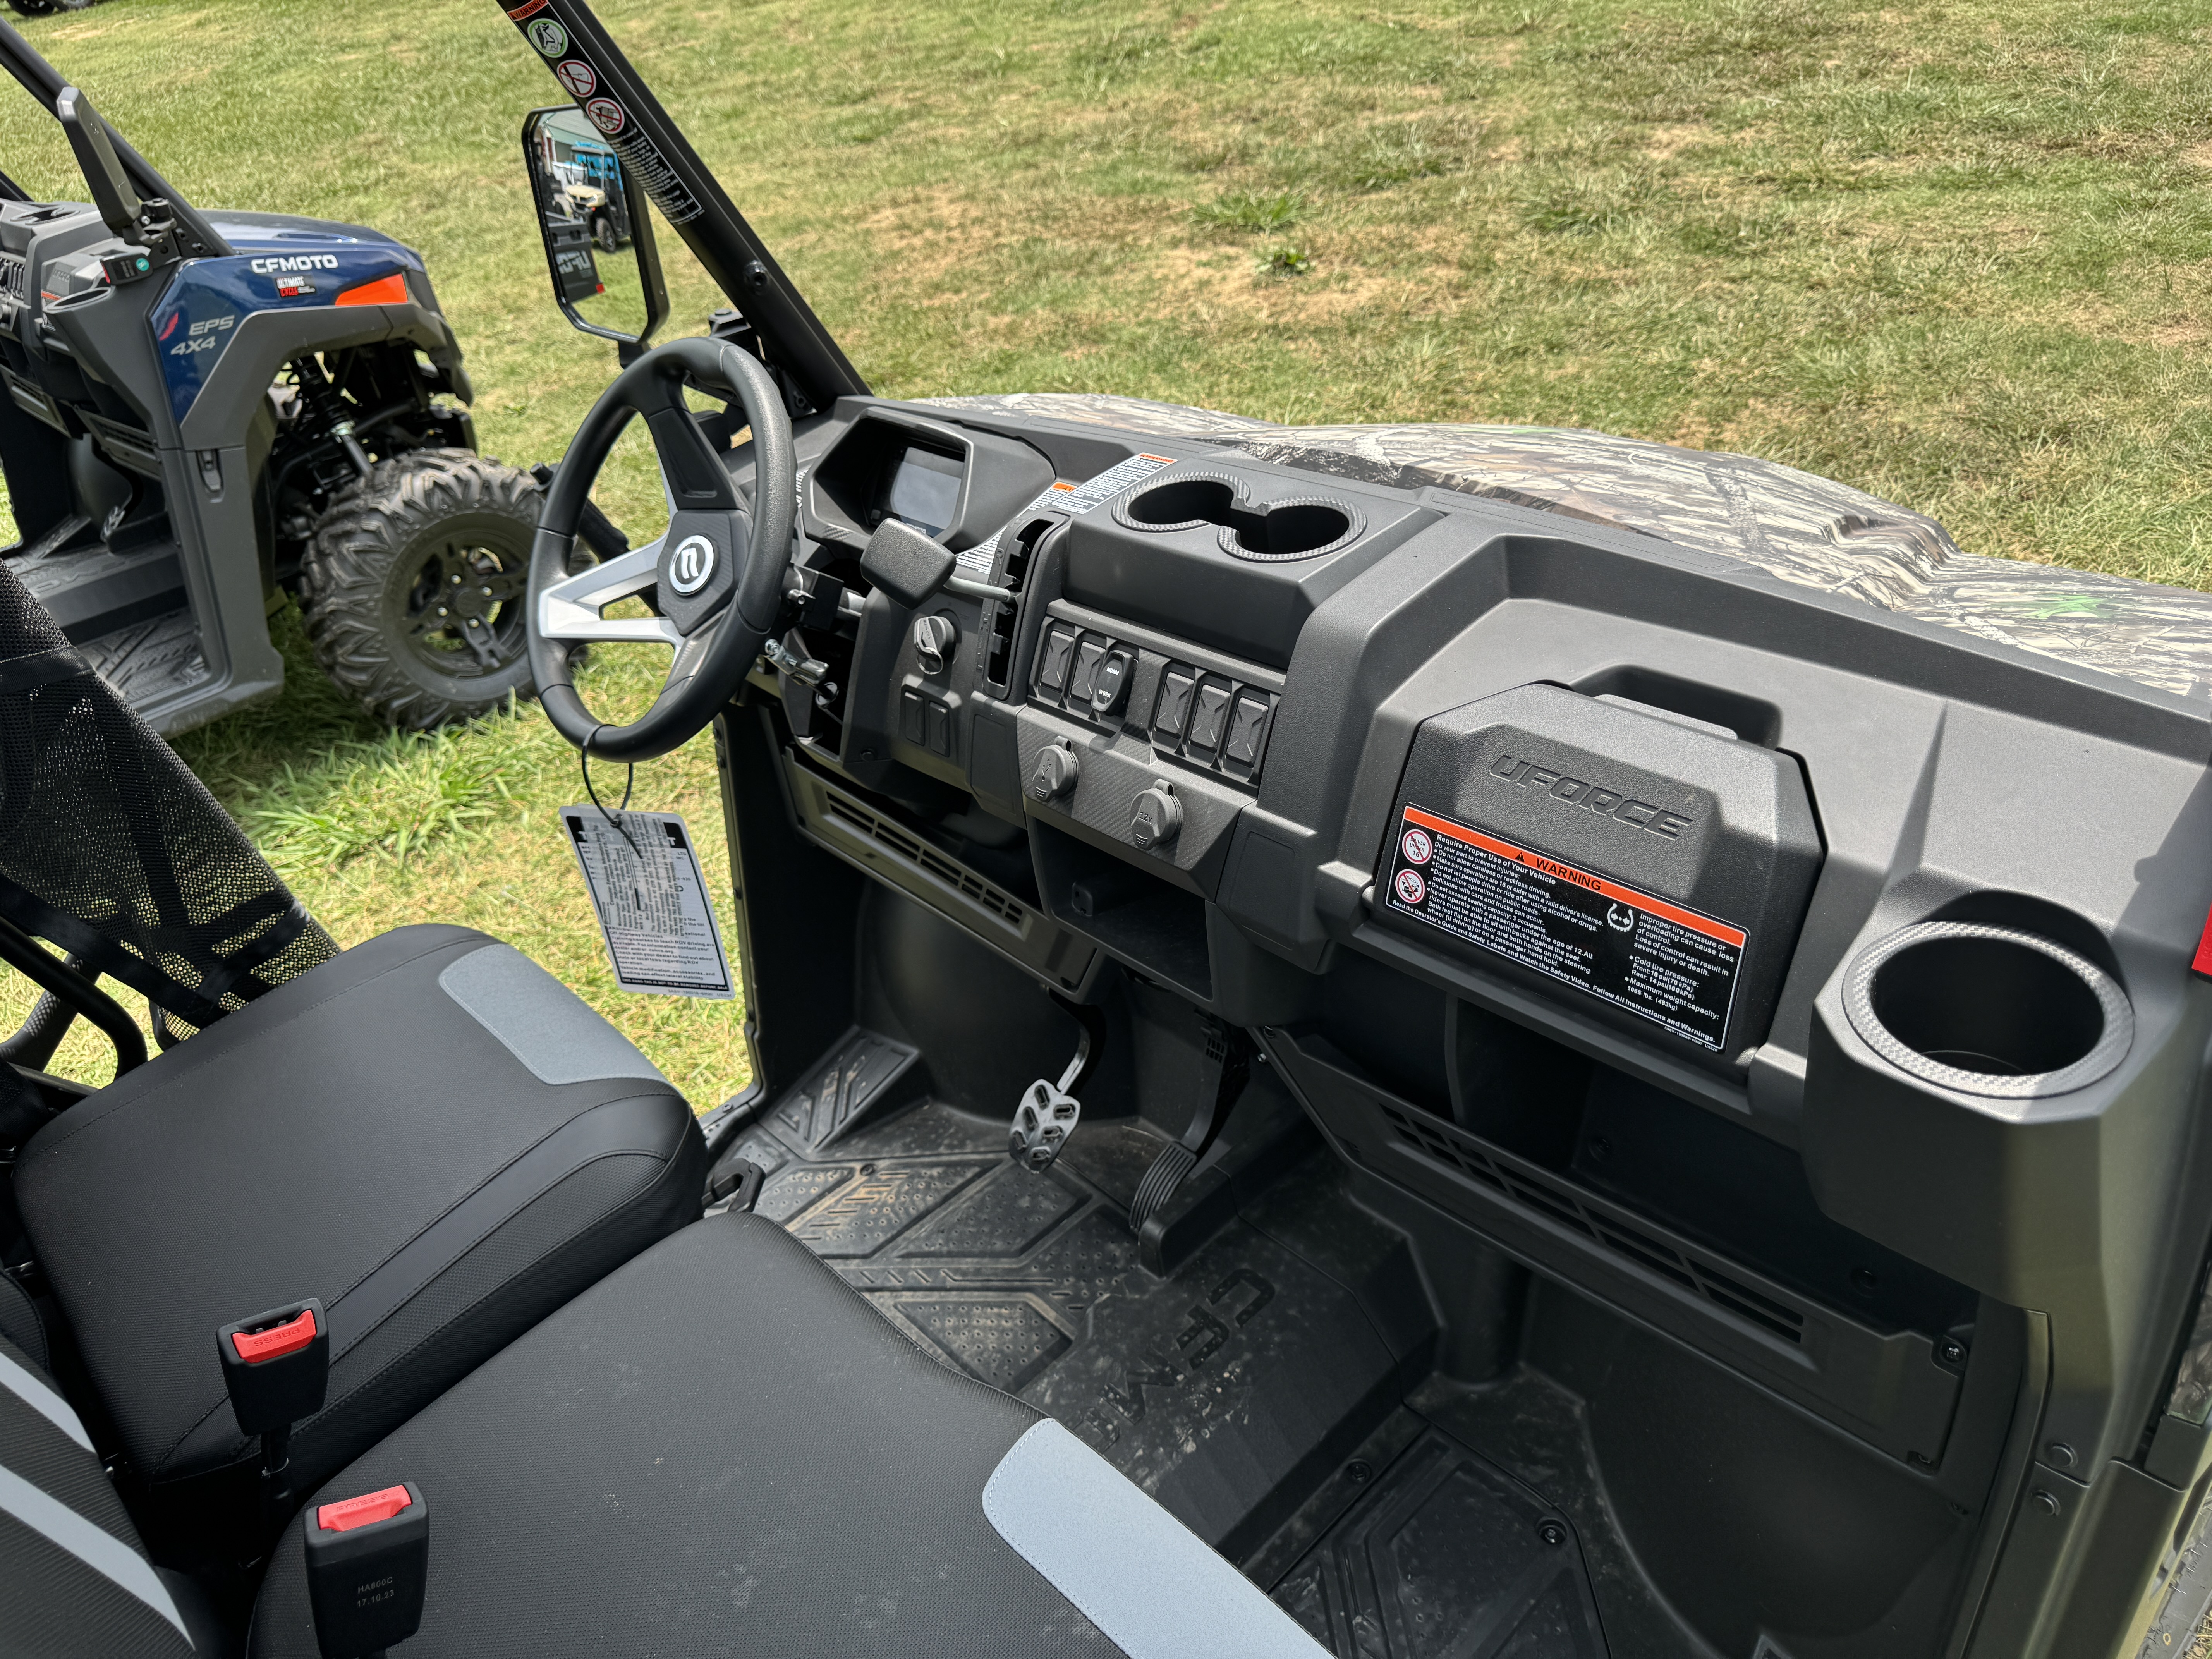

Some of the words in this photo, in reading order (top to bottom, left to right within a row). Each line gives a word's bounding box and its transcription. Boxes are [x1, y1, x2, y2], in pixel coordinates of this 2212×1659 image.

[514, 0, 546, 18] WARNING
[251, 254, 338, 273] CFMOTO
[189, 314, 235, 336] EPS
[170, 336, 216, 356] 4X4
[1106, 666, 1120, 675] NORM
[1099, 689, 1111, 698] WORK
[1490, 754, 1693, 841] UFORCE
[1410, 837, 1426, 847] DRIVER
[1436, 833, 1463, 849] Require
[1463, 844, 1487, 858] Proper
[1488, 853, 1502, 864] Use
[1511, 862, 1528, 874] Your
[1529, 869, 1556, 885] Vehicle
[1438, 849, 1446, 857] Do
[1456, 857, 1472, 867] allow
[1471, 864, 1496, 876] careless
[1503, 876, 1528, 889] reckless
[1528, 885, 1551, 899] driving.
[1443, 845, 1456, 854] your
[1455, 850, 1467, 859] part
[1474, 857, 1496, 870] prevent
[1496, 865, 1520, 879] injuries:
[1537, 857, 1601, 891] WARNING
[1432, 876, 1458, 890] collisions
[1458, 886, 1470, 895] with
[1471, 891, 1483, 900] cars
[1484, 897, 1495, 905] and
[1495, 900, 1513, 912] trucks
[1514, 909, 1525, 917] can
[1525, 914, 1544, 925] occur.
[1434, 868, 1442, 876] Do
[1451, 877, 1467, 886] allow
[1467, 883, 1494, 897] operation
[1502, 897, 1521, 908] public
[1435, 862, 1443, 870] Do
[1453, 869, 1461, 877] let
[1461, 873, 1480, 884] people
[1481, 881, 1496, 891] drive
[1503, 890, 1515, 898] ride
[1515, 895, 1530, 904] after
[1530, 901, 1547, 912] using
[1547, 908, 1570, 921] alcohol
[1578, 919, 1598, 932] drugs.
[1436, 855, 1451, 866] Make
[1451, 862, 1463, 871] sure
[1463, 867, 1488, 881] operators
[1513, 887, 1528, 896] older
[1528, 893, 1540, 901] with
[1545, 899, 1559, 909] valid
[1559, 905, 1580, 917] driver's
[1580, 912, 1604, 927] license.
[1448, 890, 1467, 901] exceed
[1467, 898, 1487, 910] seating
[1487, 906, 1512, 919] capacity:
[1517, 918, 1547, 934] occupants.
[1427, 907, 1444, 918] wheel
[1452, 918, 1474, 932] driving)
[1494, 936, 1527, 953] passenger
[1527, 949, 1543, 960] hand
[1543, 956, 1559, 967] hold.
[1638, 921, 1680, 942] overloading
[1680, 937, 1693, 946] can
[1694, 943, 1716, 955] cause
[1718, 950, 1734, 962] loss
[1640, 912, 1672, 930] Improper
[1672, 925, 1684, 935] tire
[1685, 931, 1717, 948] pressure
[1645, 931, 1671, 945] control.
[1392, 899, 1405, 909] Read
[1414, 908, 1441, 924] Operator's
[1441, 920, 1457, 931] Guide
[1468, 931, 1486, 944] Safety
[1486, 939, 1506, 952] Labels
[1506, 949, 1519, 957] and
[1519, 953, 1538, 966] Watch
[1539, 962, 1549, 971] the
[1549, 967, 1570, 981] Safety
[1571, 975, 1591, 989] Video.
[1592, 984, 1614, 998] Follow
[1614, 994, 1625, 1003] All
[1625, 998, 1666, 1021] Instructions
[1666, 1018, 1680, 1027] and
[1681, 1022, 1715, 1043] Warnings.
[1633, 942, 1657, 955] severe
[1658, 950, 1678, 964] injury
[1687, 963, 1709, 976] death.
[1635, 933, 1652, 945] Loss
[1660, 945, 1685, 959] control
[1686, 955, 1699, 964] can
[1700, 960, 1721, 973] result
[1721, 968, 1729, 976] in
[1631, 969, 1648, 981] Rear:
[1634, 956, 1651, 968] Cold
[1652, 963, 1664, 973] tire
[1664, 969, 1699, 988] pressure:
[1627, 985, 1642, 995] 1065
[1642, 991, 1653, 1001] lbs.
[1629, 977, 1662, 996] Maximum
[1663, 992, 1687, 1006] weight
[1687, 1003, 1719, 1020] capacity:
[254, 1328, 300, 1346] PRESS
[337, 1494, 389, 1512] PRESS
